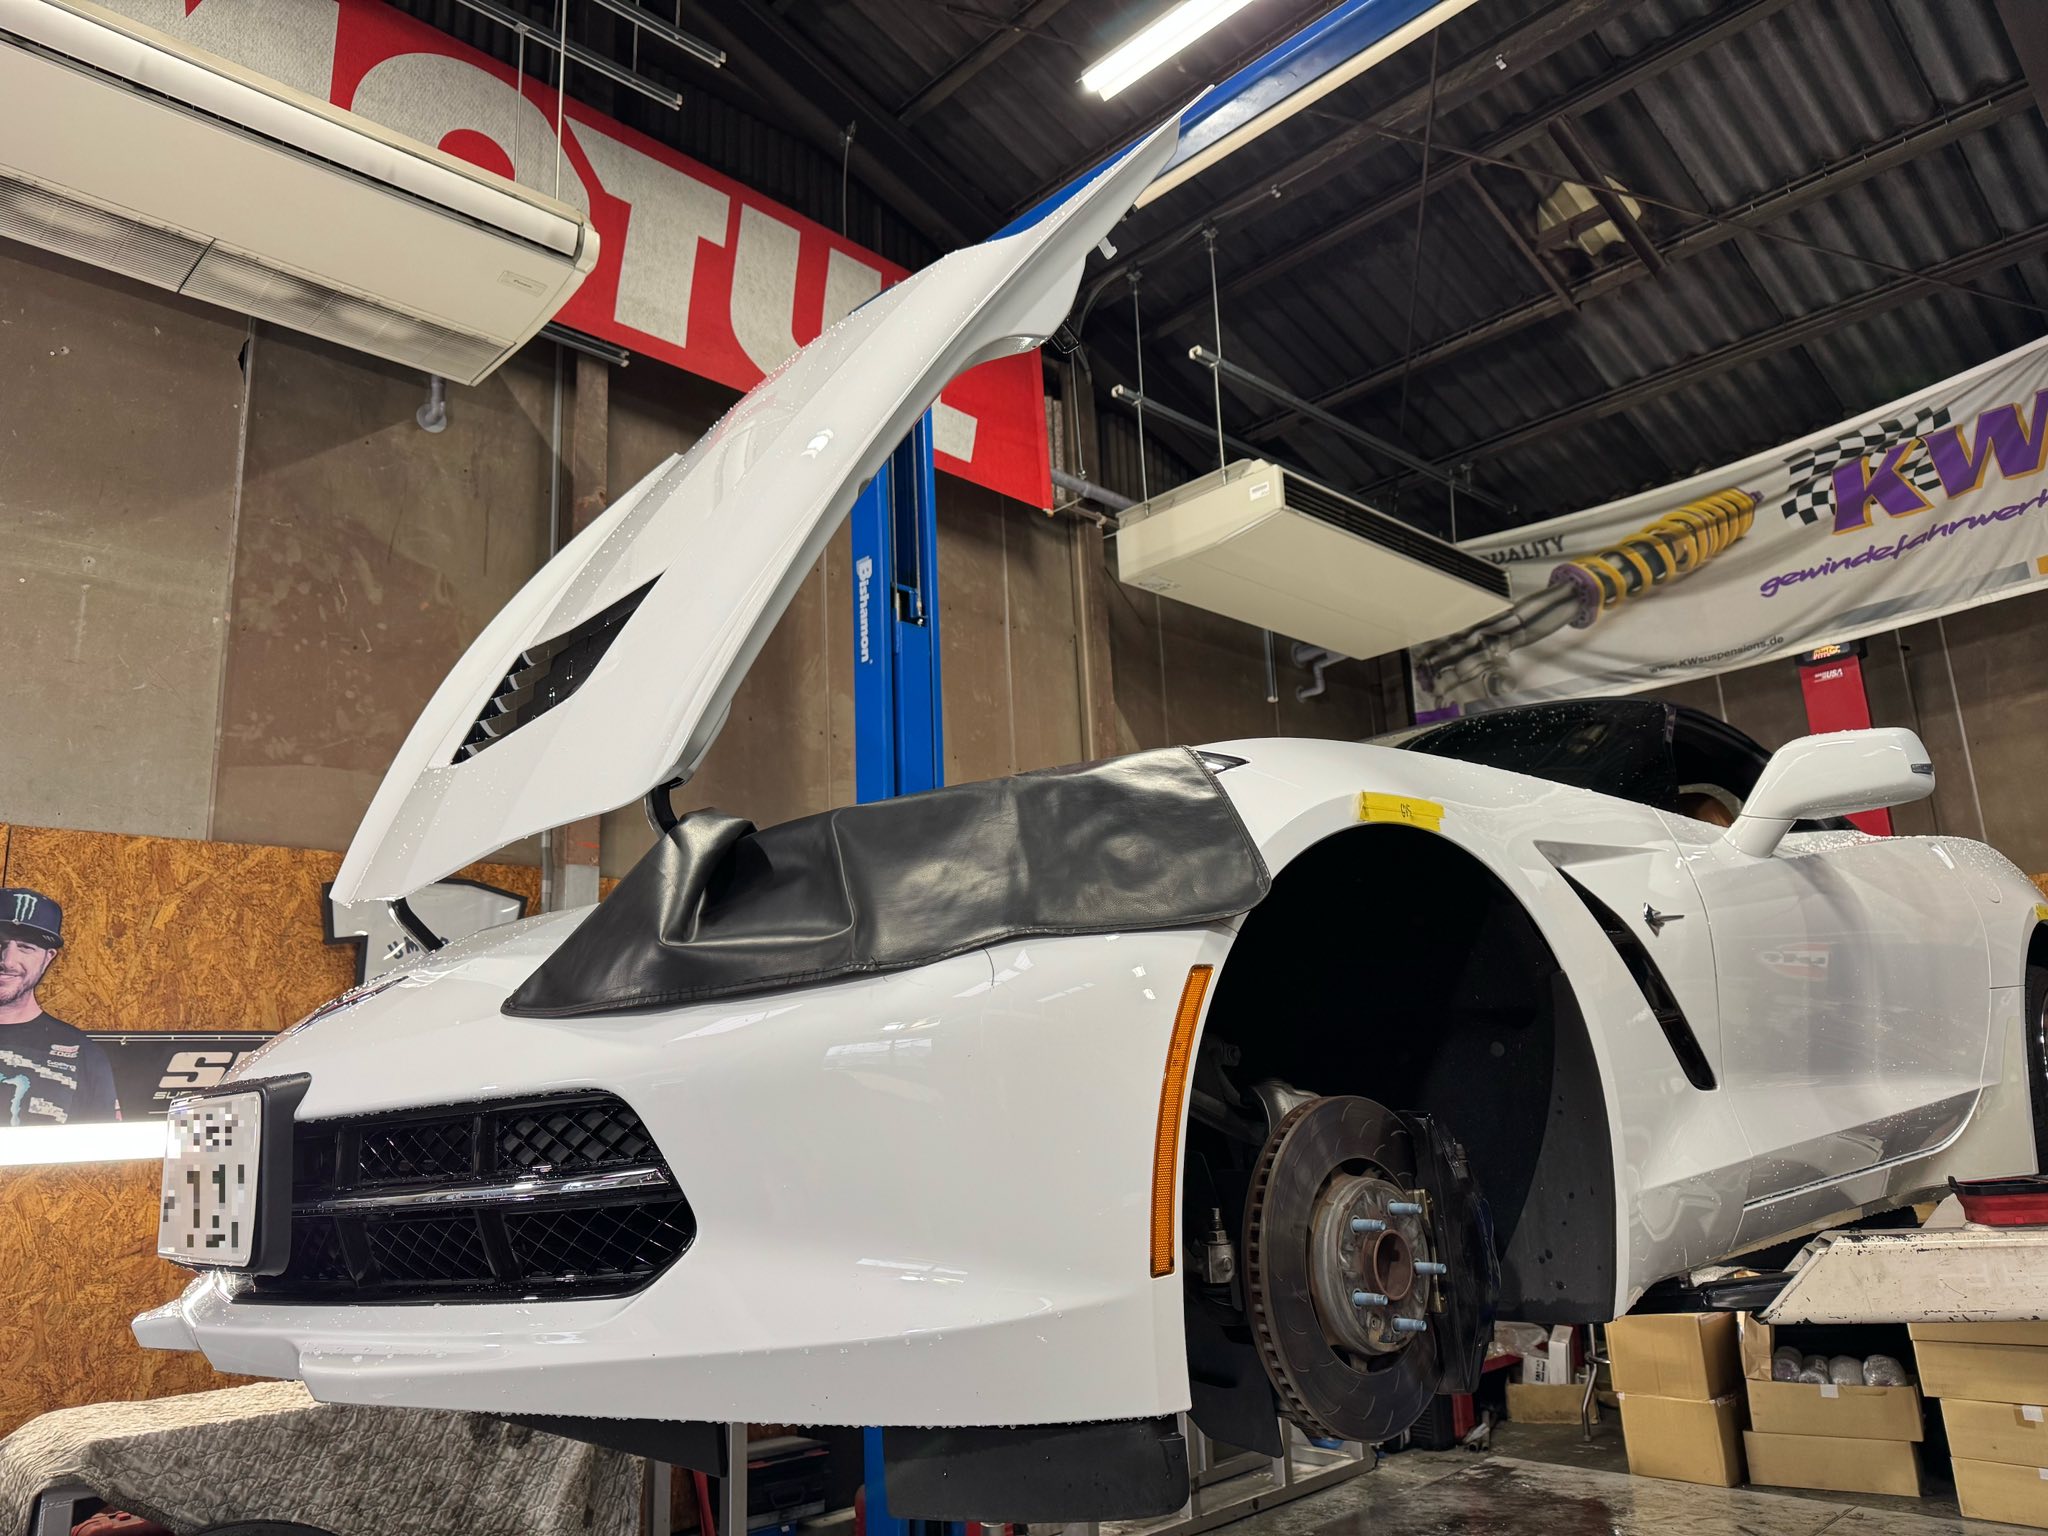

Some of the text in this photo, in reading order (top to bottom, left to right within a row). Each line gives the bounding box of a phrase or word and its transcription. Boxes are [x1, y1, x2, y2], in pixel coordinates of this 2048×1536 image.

[1831, 388, 2048, 535] KW
[856, 555, 873, 664] Bishamon
[1649, 636, 1784, 674] www.KWsuspensions.de
